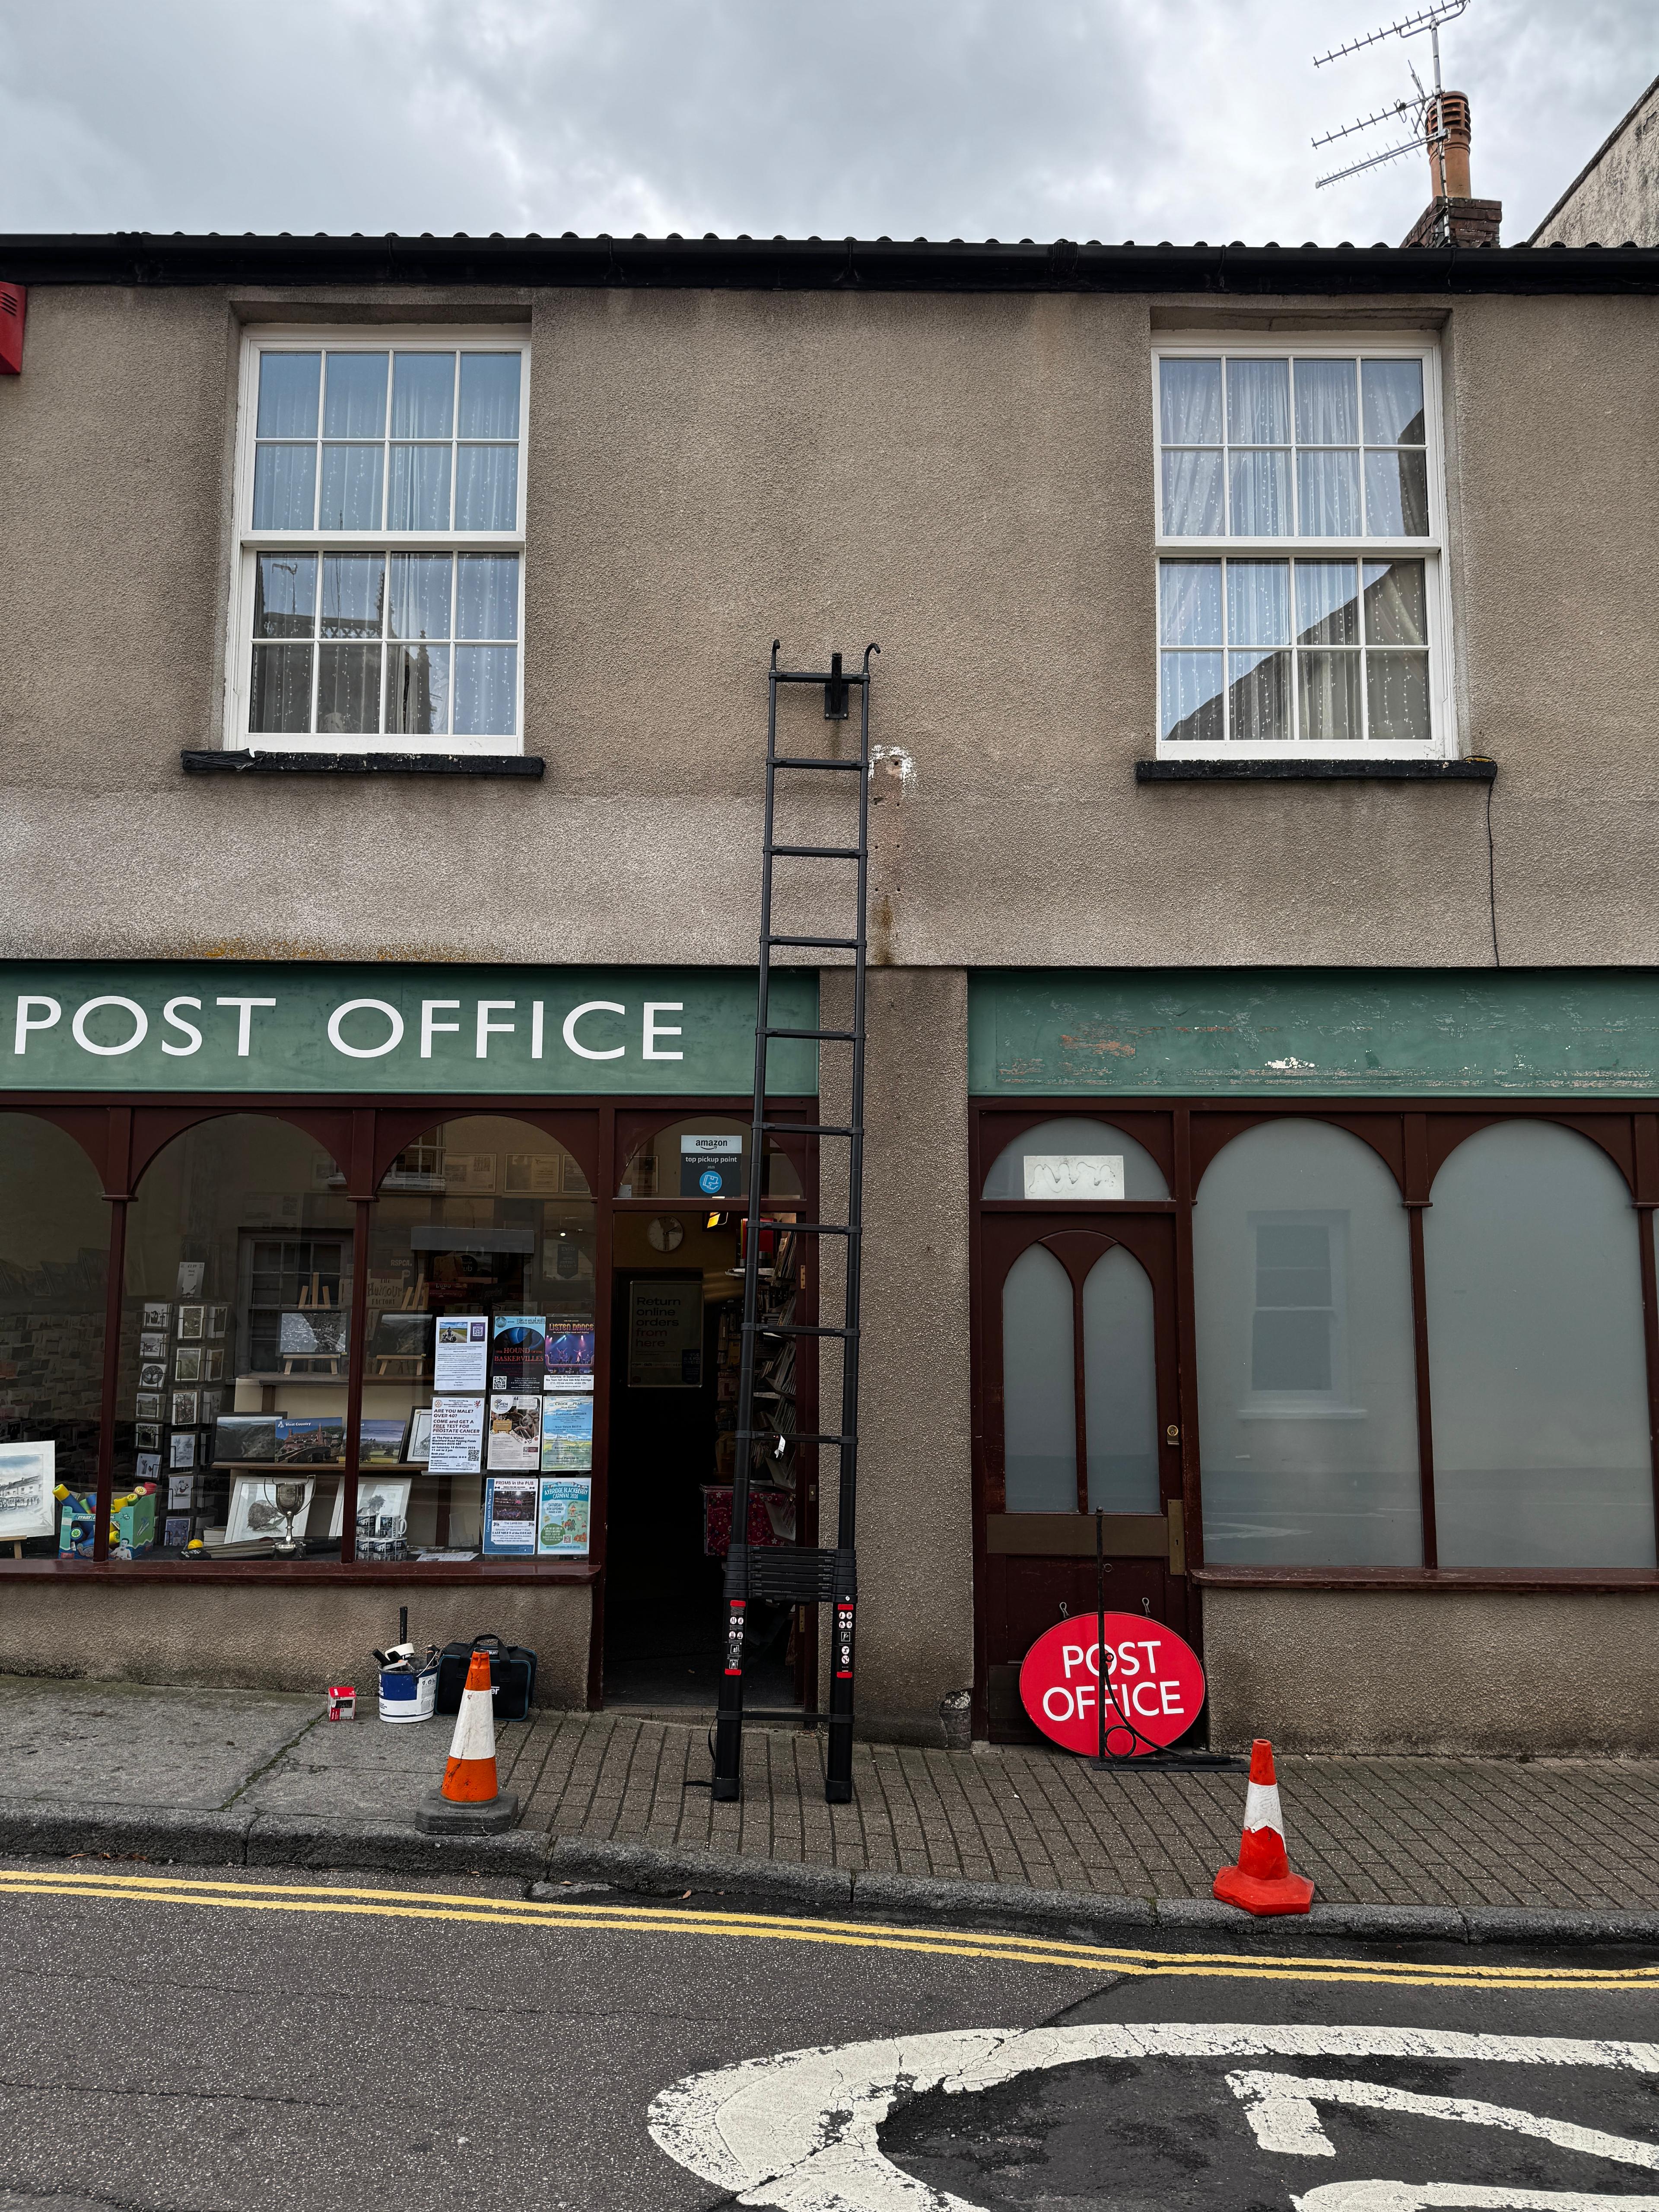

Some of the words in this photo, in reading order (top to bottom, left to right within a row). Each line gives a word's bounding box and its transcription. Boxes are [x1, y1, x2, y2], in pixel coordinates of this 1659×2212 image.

[14, 996, 276, 1056] POST
[327, 998, 683, 1060] OFFICE
[637, 1297, 681, 1306] Return
[636, 1308, 676, 1316] online
[636, 1318, 679, 1326] orders
[636, 1328, 667, 1337] from
[636, 1338, 665, 1347] here
[1062, 1641, 1161, 1678] POST
[1042, 1681, 1184, 1722] OFFICE
